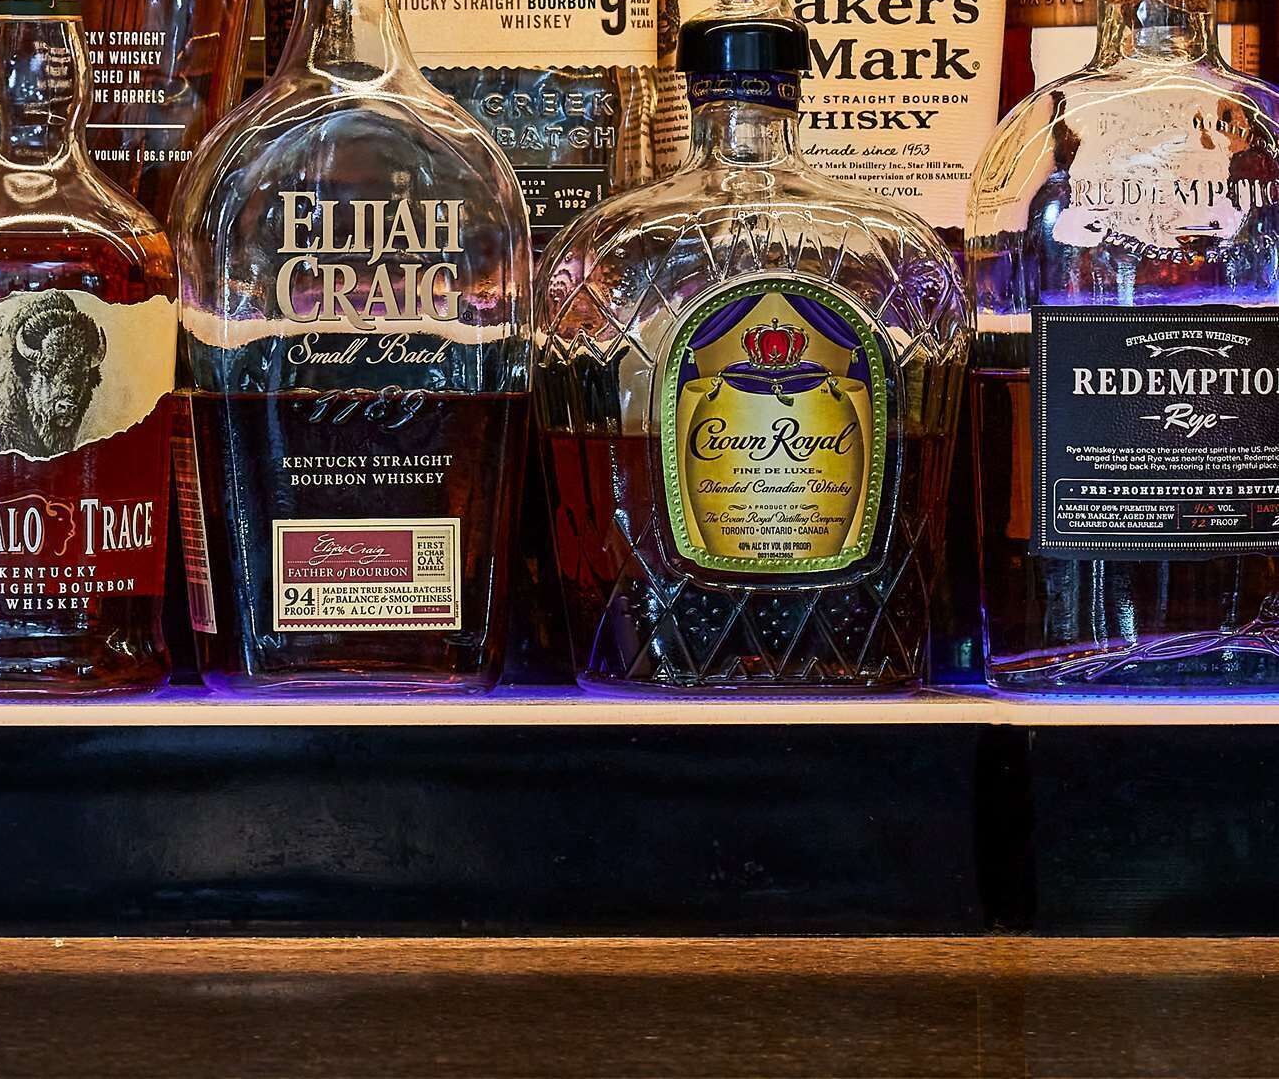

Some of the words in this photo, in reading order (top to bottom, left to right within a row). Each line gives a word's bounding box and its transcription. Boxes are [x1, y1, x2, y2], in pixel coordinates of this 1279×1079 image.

[501, 15, 571, 28] WHISKEY
[801, 38, 977, 81] Mark
[823, 95, 895, 103] STRAIGHT
[903, 95, 968, 103] BOURBON
[862, 146, 897, 156] since
[902, 144, 930, 156] 1953
[277, 192, 464, 265] ELIJAH
[276, 256, 462, 330] CRAIG
[1126, 331, 1179, 346] STRAIGHT
[1205, 331, 1251, 345] WHISKEY
[287, 333, 368, 364] Small
[366, 333, 452, 364] Batch
[1073, 368, 1279, 395] REDEMPTIO
[1164, 403, 1217, 438] Rye
[691, 418, 767, 461] Crown
[749, 418, 857, 461] Royal
[1083, 446, 1117, 454] Whiskey
[1172, 446, 1207, 455] preferred
[1209, 446, 1228, 455] spirit
[282, 457, 368, 468] KENTUCKY
[373, 455, 453, 466] STRAIGHT
[291, 474, 366, 486] BOURBON
[373, 473, 444, 484] WHISKEY
[697, 480, 749, 494] Blended
[753, 480, 806, 494] Canadian
[807, 480, 852, 496] Whisky
[1081, 486, 1203, 495] PRE-PROHIBITION
[1209, 486, 1233, 494] RYE
[721, 527, 755, 535] TORONTO
[760, 526, 792, 535] ONTARIO
[798, 526, 829, 535] CANADA
[0, 566, 96, 578] KENTUCKY
[288, 568, 334, 577] FATHER
[337, 568, 348, 579] of
[349, 568, 408, 577] BOURBON
[60, 579, 134, 593] BOURBON
[6, 598, 90, 609] WHISKEY
[284, 588, 315, 606] 94
[284, 607, 315, 615] PROOF
